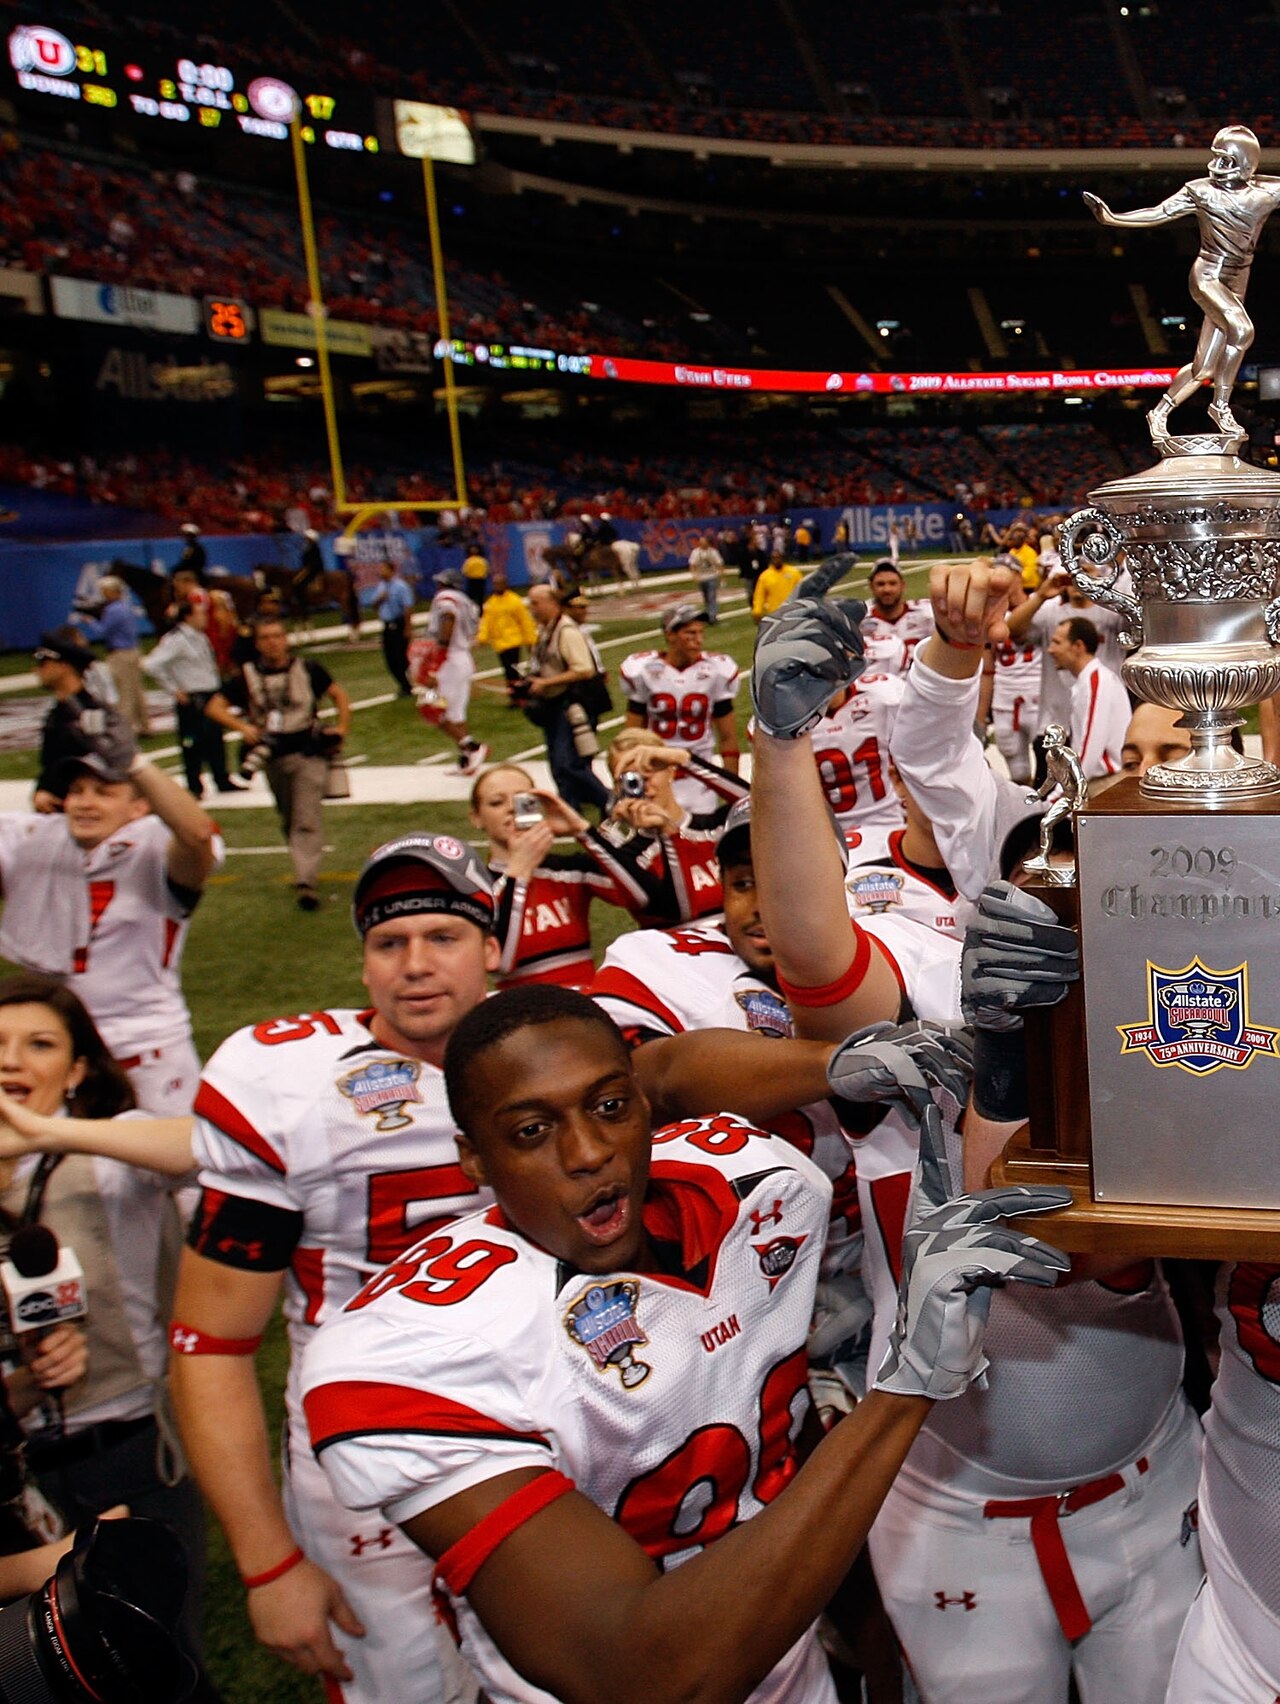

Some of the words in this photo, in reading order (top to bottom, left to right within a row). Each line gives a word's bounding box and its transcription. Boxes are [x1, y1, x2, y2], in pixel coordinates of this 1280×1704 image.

[909, 375, 940, 390] 2009
[1149, 845, 1238, 879] 2009
[384, 897, 446, 915] UNDER
[1171, 994, 1222, 1008] Allstate
[1133, 1030, 1153, 1043] 1934
[1245, 1031, 1267, 1045] 2009
[1176, 1042, 1241, 1061] ANNIVERSARY
[700, 1313, 742, 1354] UTAH
